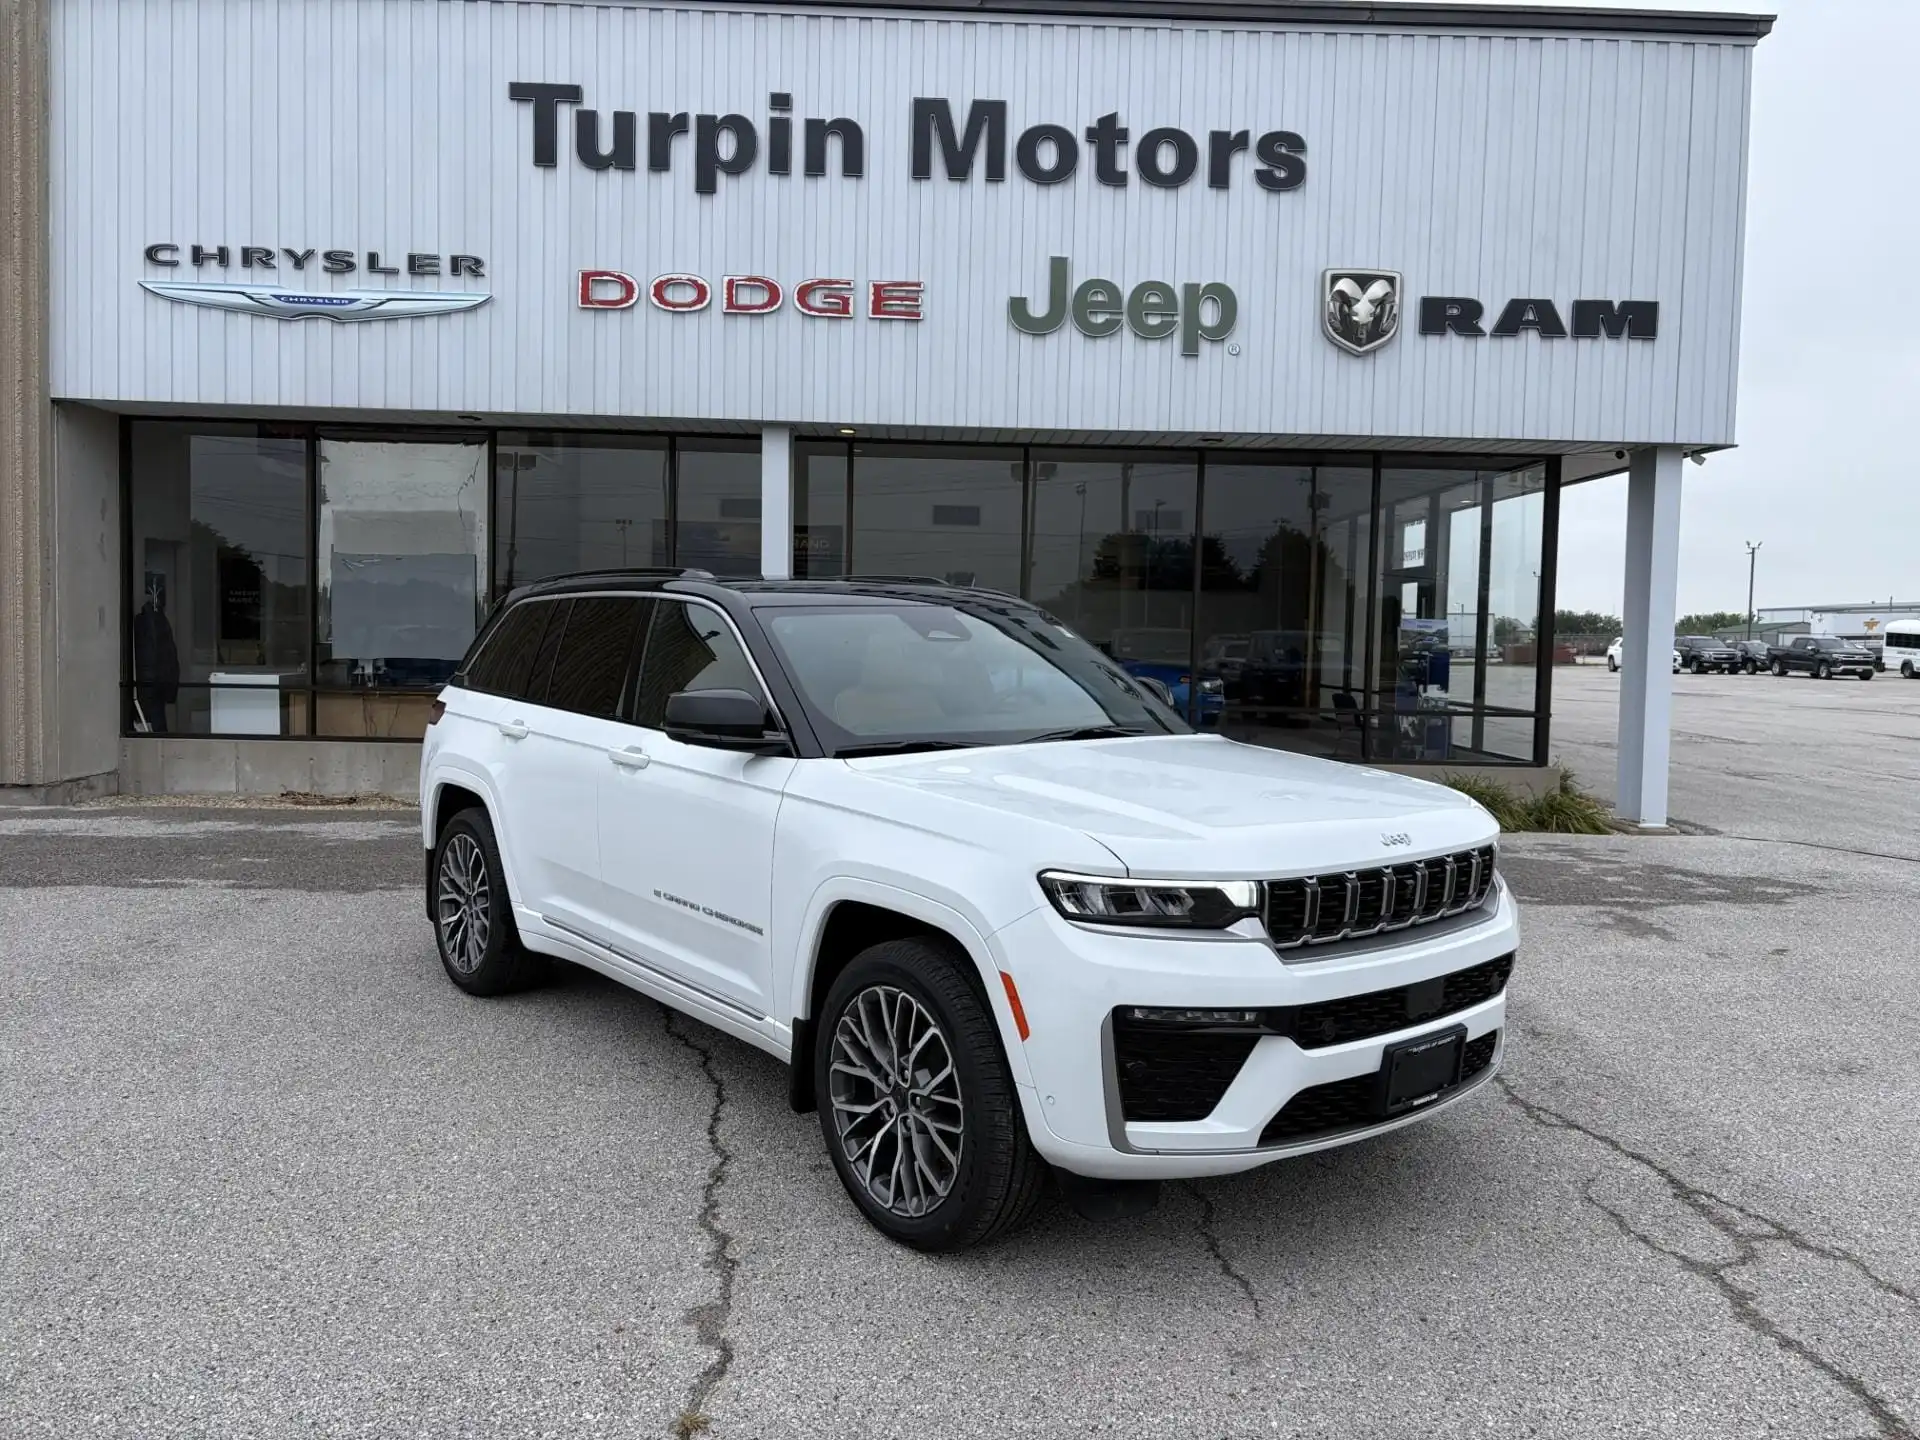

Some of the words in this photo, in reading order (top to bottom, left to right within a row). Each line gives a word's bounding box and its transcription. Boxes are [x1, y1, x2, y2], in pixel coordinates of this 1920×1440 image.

[509, 82, 864, 193] Turpin
[911, 97, 1308, 191] Motors
[144, 243, 486, 277] CHRYSLER
[280, 296, 349, 304] CHRYSLER
[578, 270, 924, 320] DODGE
[1009, 257, 1238, 356] Jeep
[1418, 295, 1659, 340] RAM
[1380, 833, 1412, 846] Jeep
